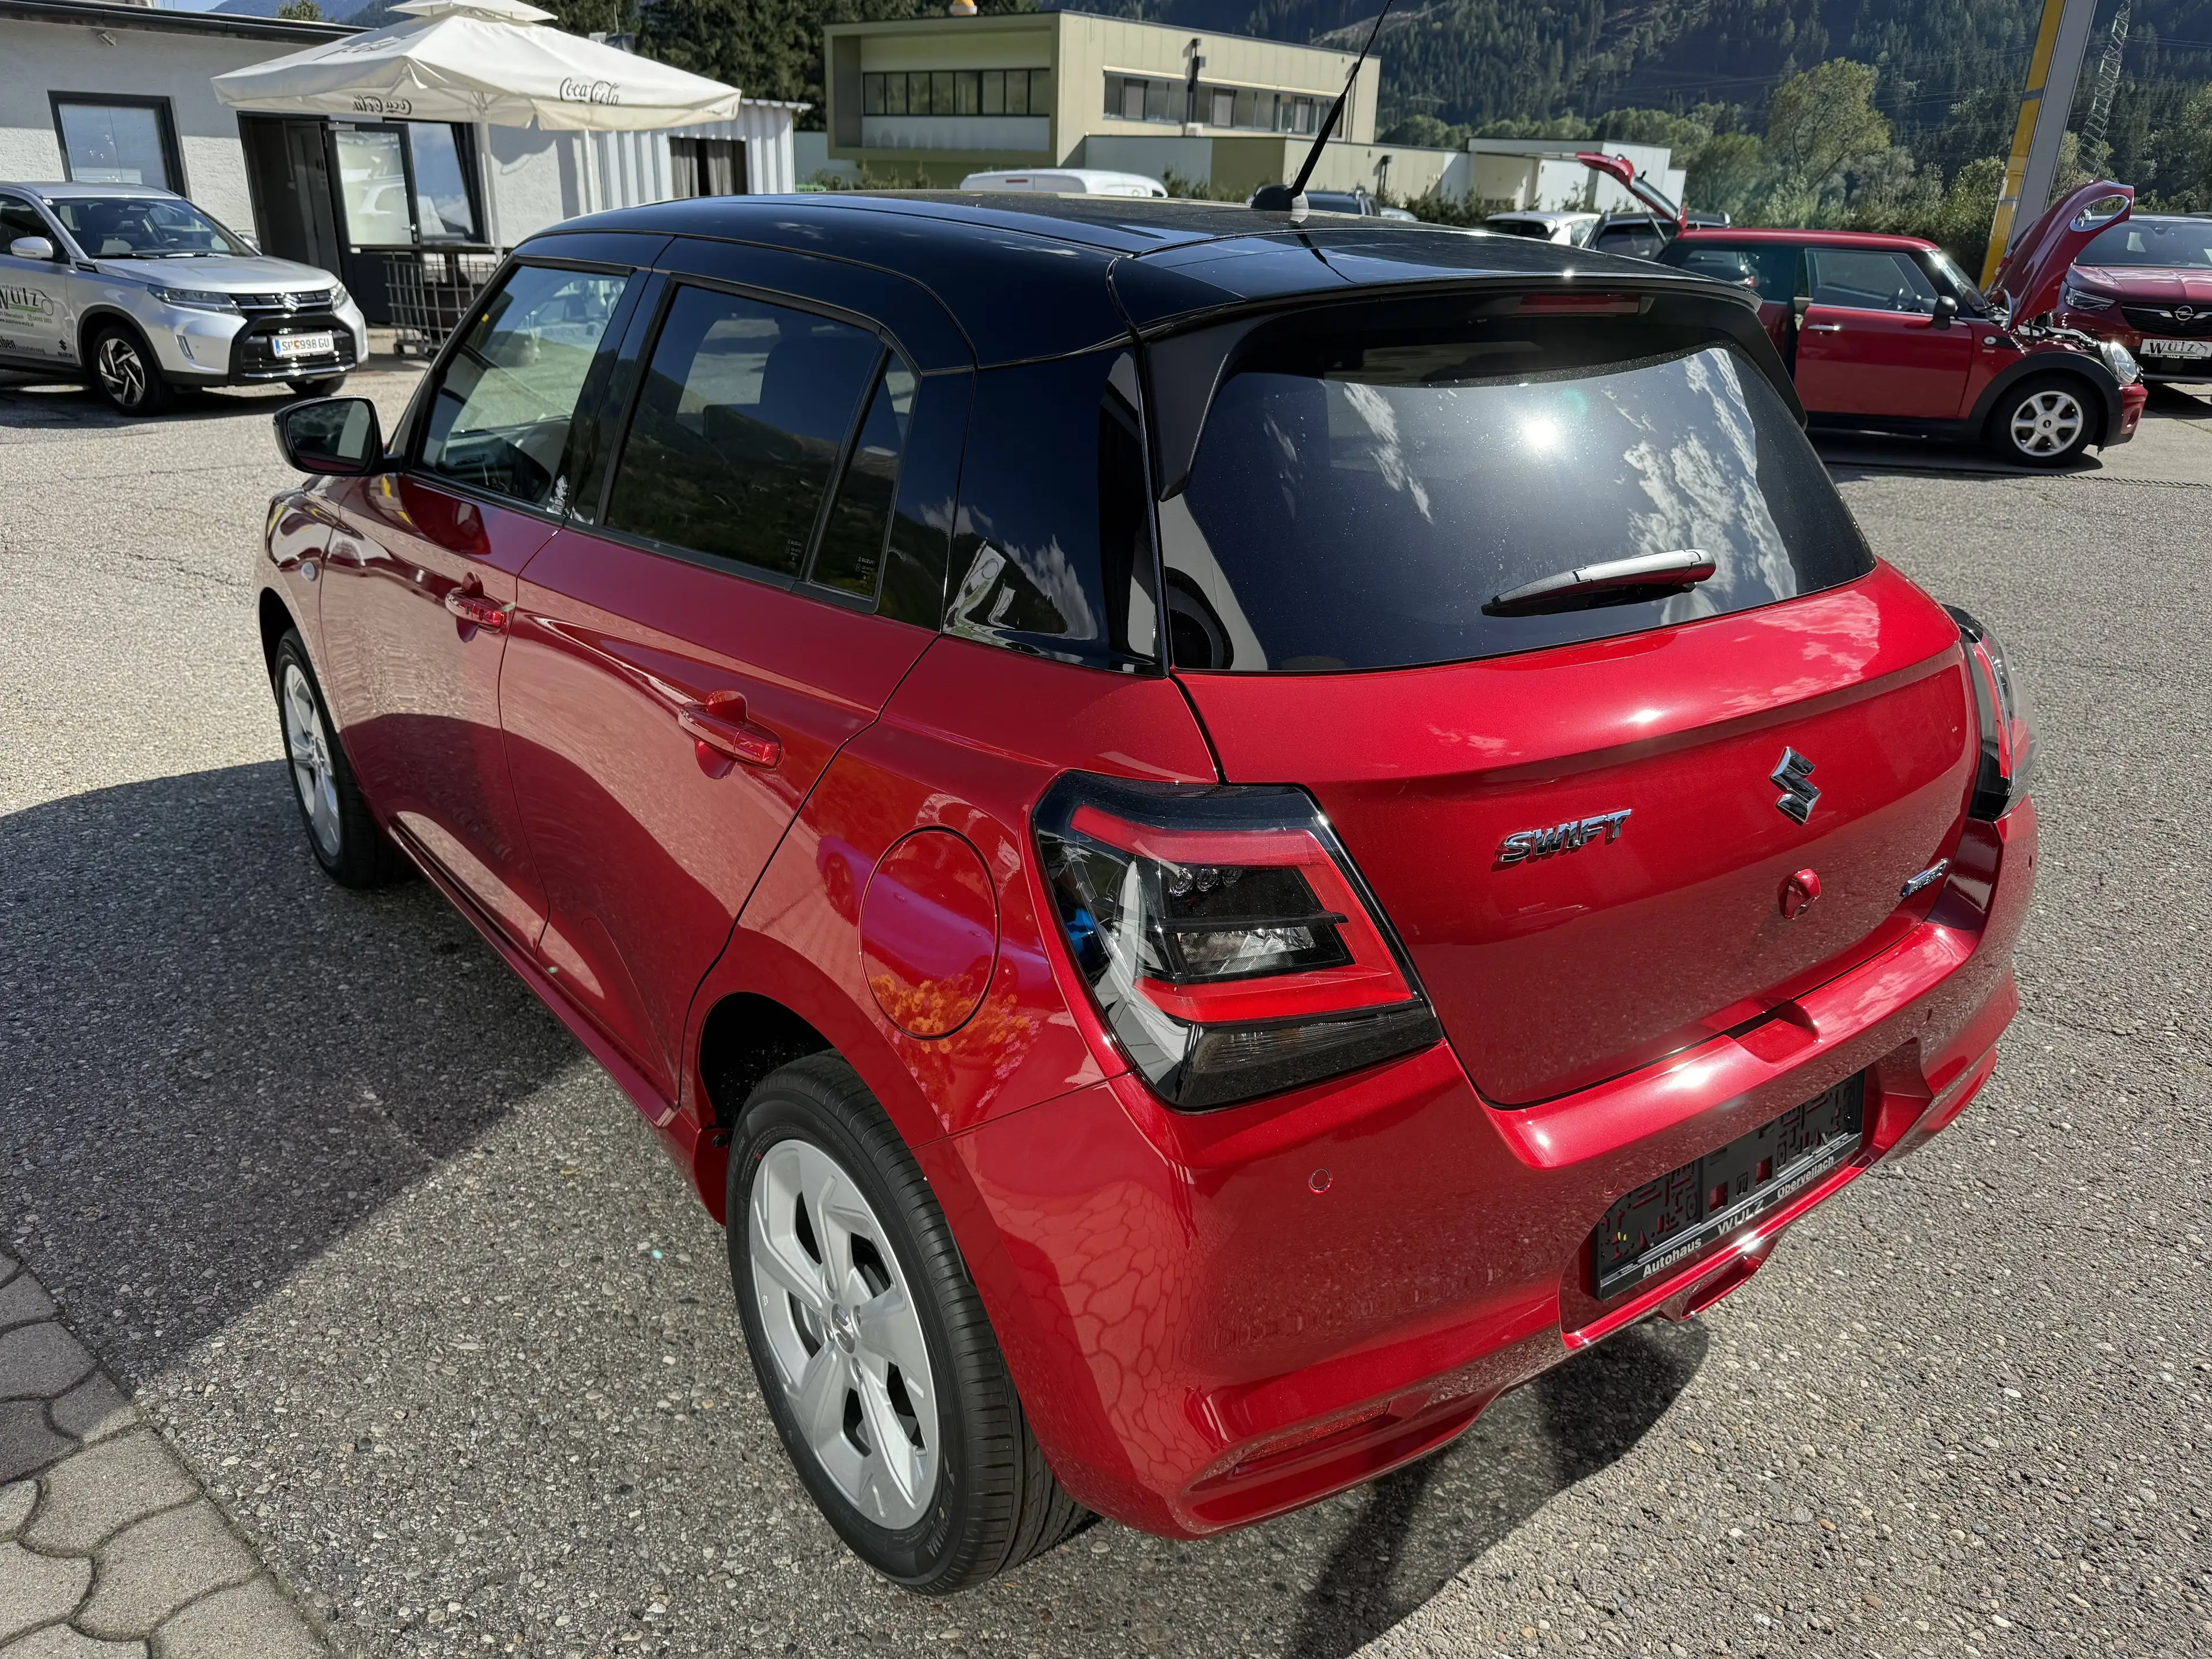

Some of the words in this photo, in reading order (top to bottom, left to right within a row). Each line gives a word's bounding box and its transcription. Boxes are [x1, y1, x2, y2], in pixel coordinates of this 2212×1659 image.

[282, 341, 293, 351] SP
[318, 338, 329, 348] GU
[1499, 808, 1633, 863] SWIFT
[1642, 1237, 1702, 1278] Autohaus
[1717, 1199, 1764, 1235] WULZ
[1777, 1156, 1834, 1199] Obervellach
